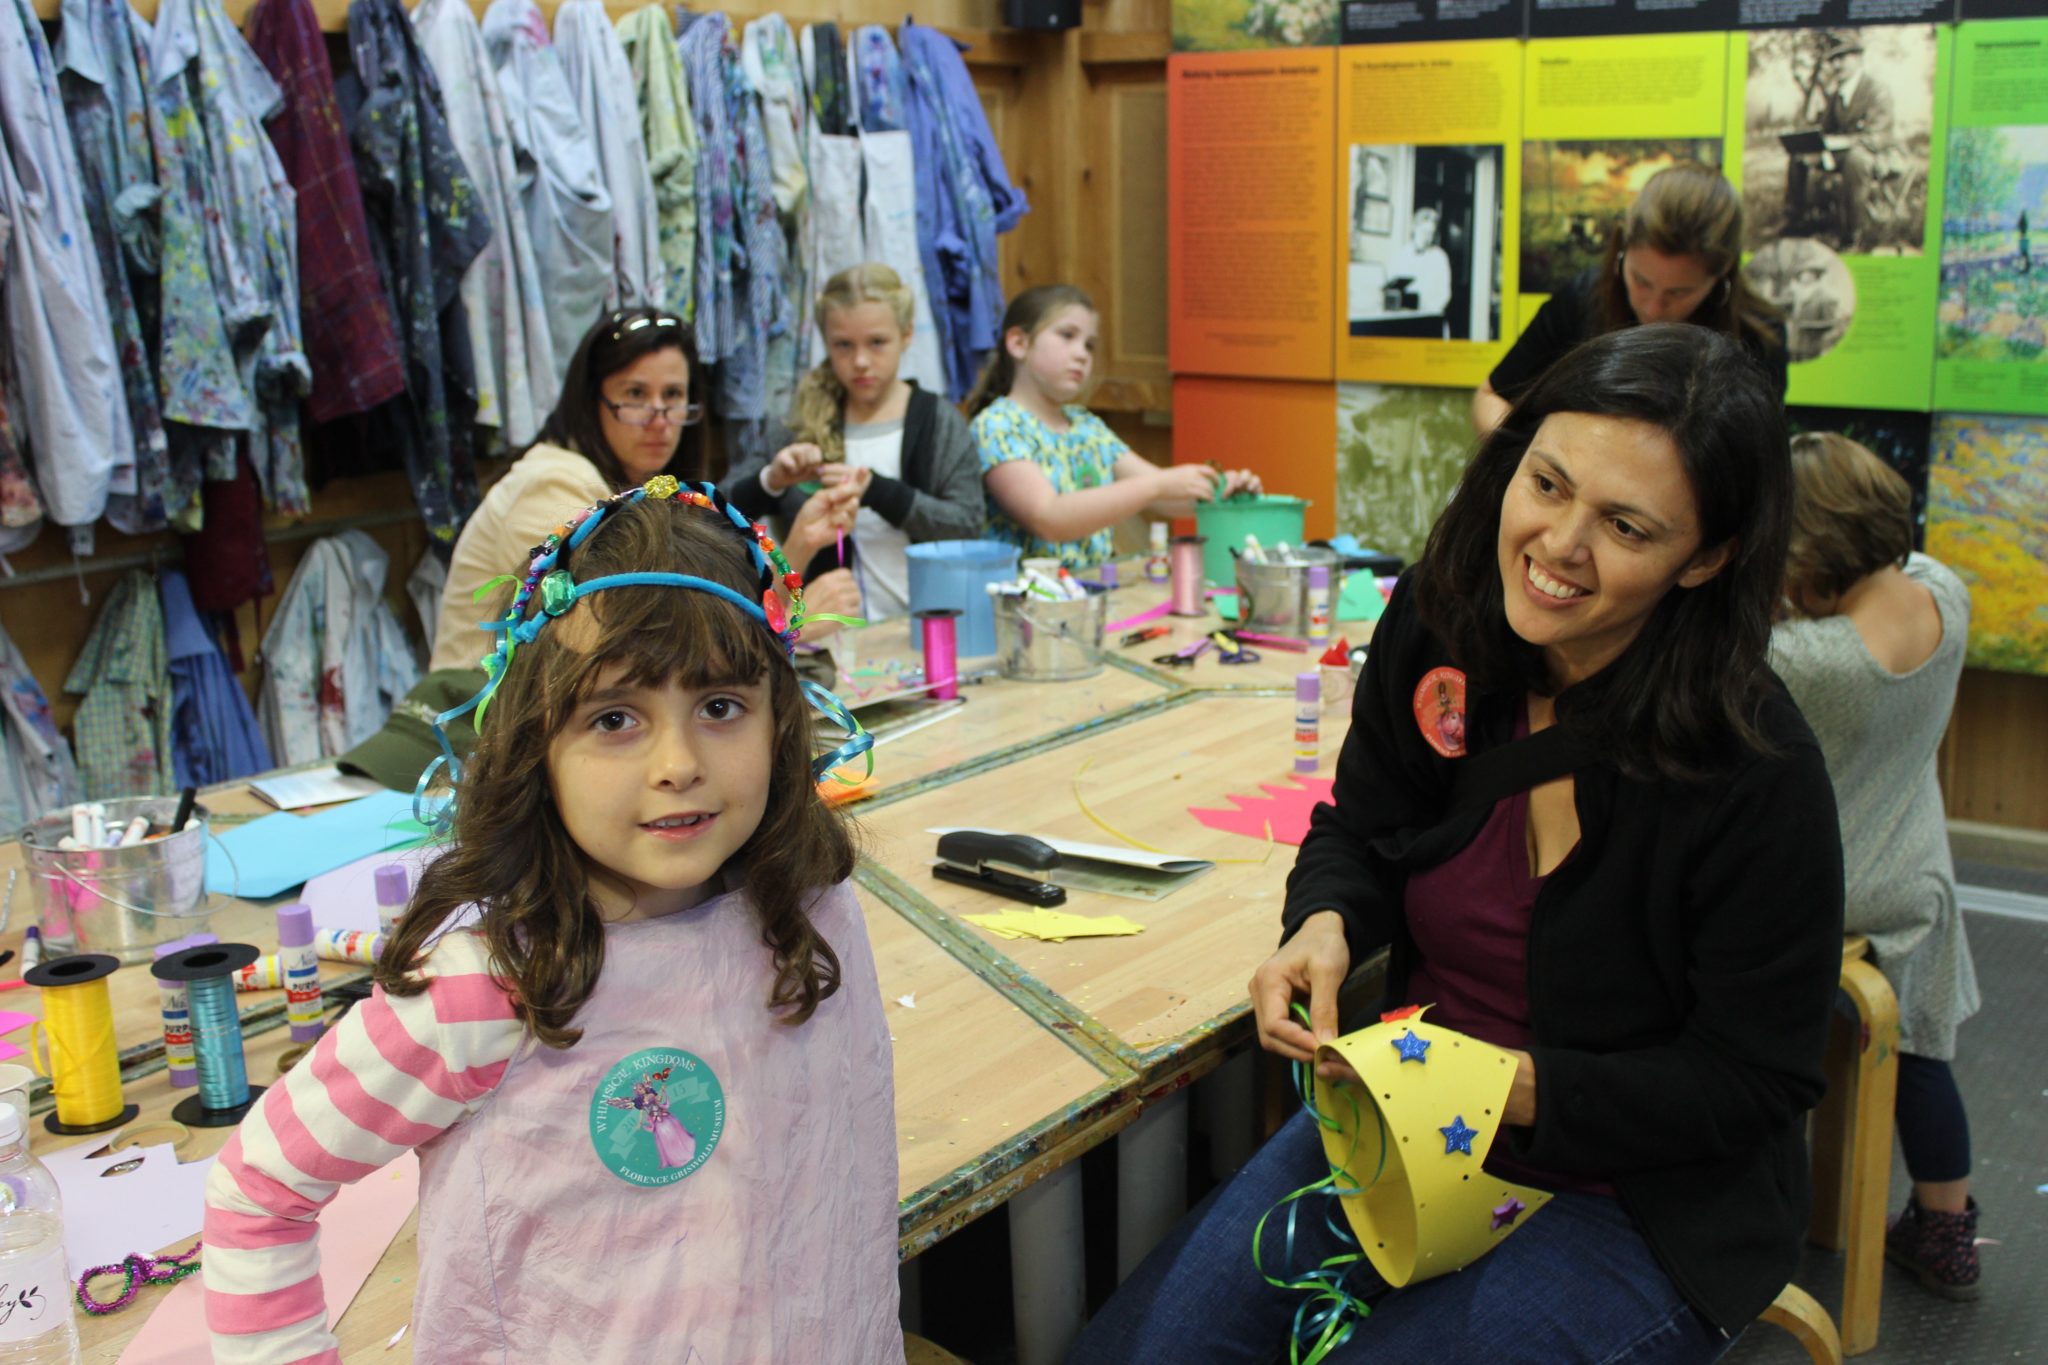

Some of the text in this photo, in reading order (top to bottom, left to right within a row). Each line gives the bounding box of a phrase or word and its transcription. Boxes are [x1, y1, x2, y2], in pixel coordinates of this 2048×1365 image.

[596, 1054, 697, 1134] WHIMSICAL KINGDOMS
[672, 1084, 687, 1098] 15
[619, 1099, 722, 1184] FLORENCE GRISWOLD MUSEUM
